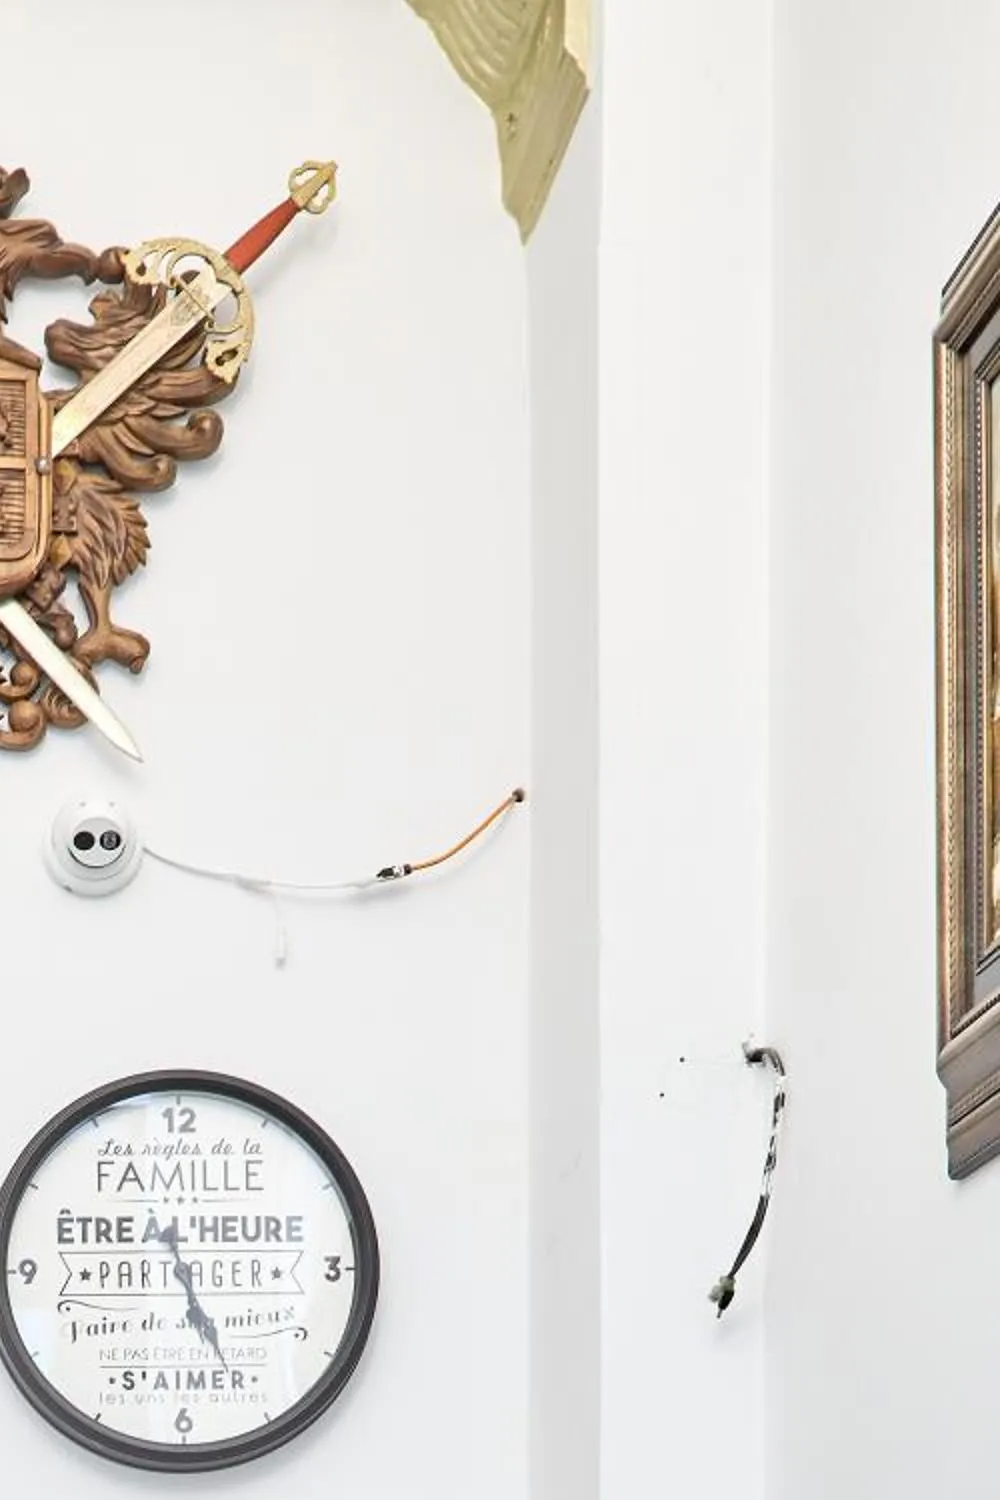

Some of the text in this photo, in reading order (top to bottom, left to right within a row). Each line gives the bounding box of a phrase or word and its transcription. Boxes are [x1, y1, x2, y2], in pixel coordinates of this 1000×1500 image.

[162, 1107, 197, 1133] 12
[98, 1138, 134, 1156] Les
[210, 1138, 234, 1155] de
[243, 1138, 264, 1155] la
[97, 1160, 266, 1192] FAMILLE
[57, 1208, 135, 1244] ÊTRE
[170, 1215, 304, 1243] L'HEURE
[19, 1259, 37, 1285] 9
[99, 1259, 263, 1289] PARTAGER
[324, 1256, 341, 1282] 3
[141, 1311, 166, 1332] de
[122, 1370, 245, 1391] S'AIMER
[174, 1407, 194, 1433] 6
